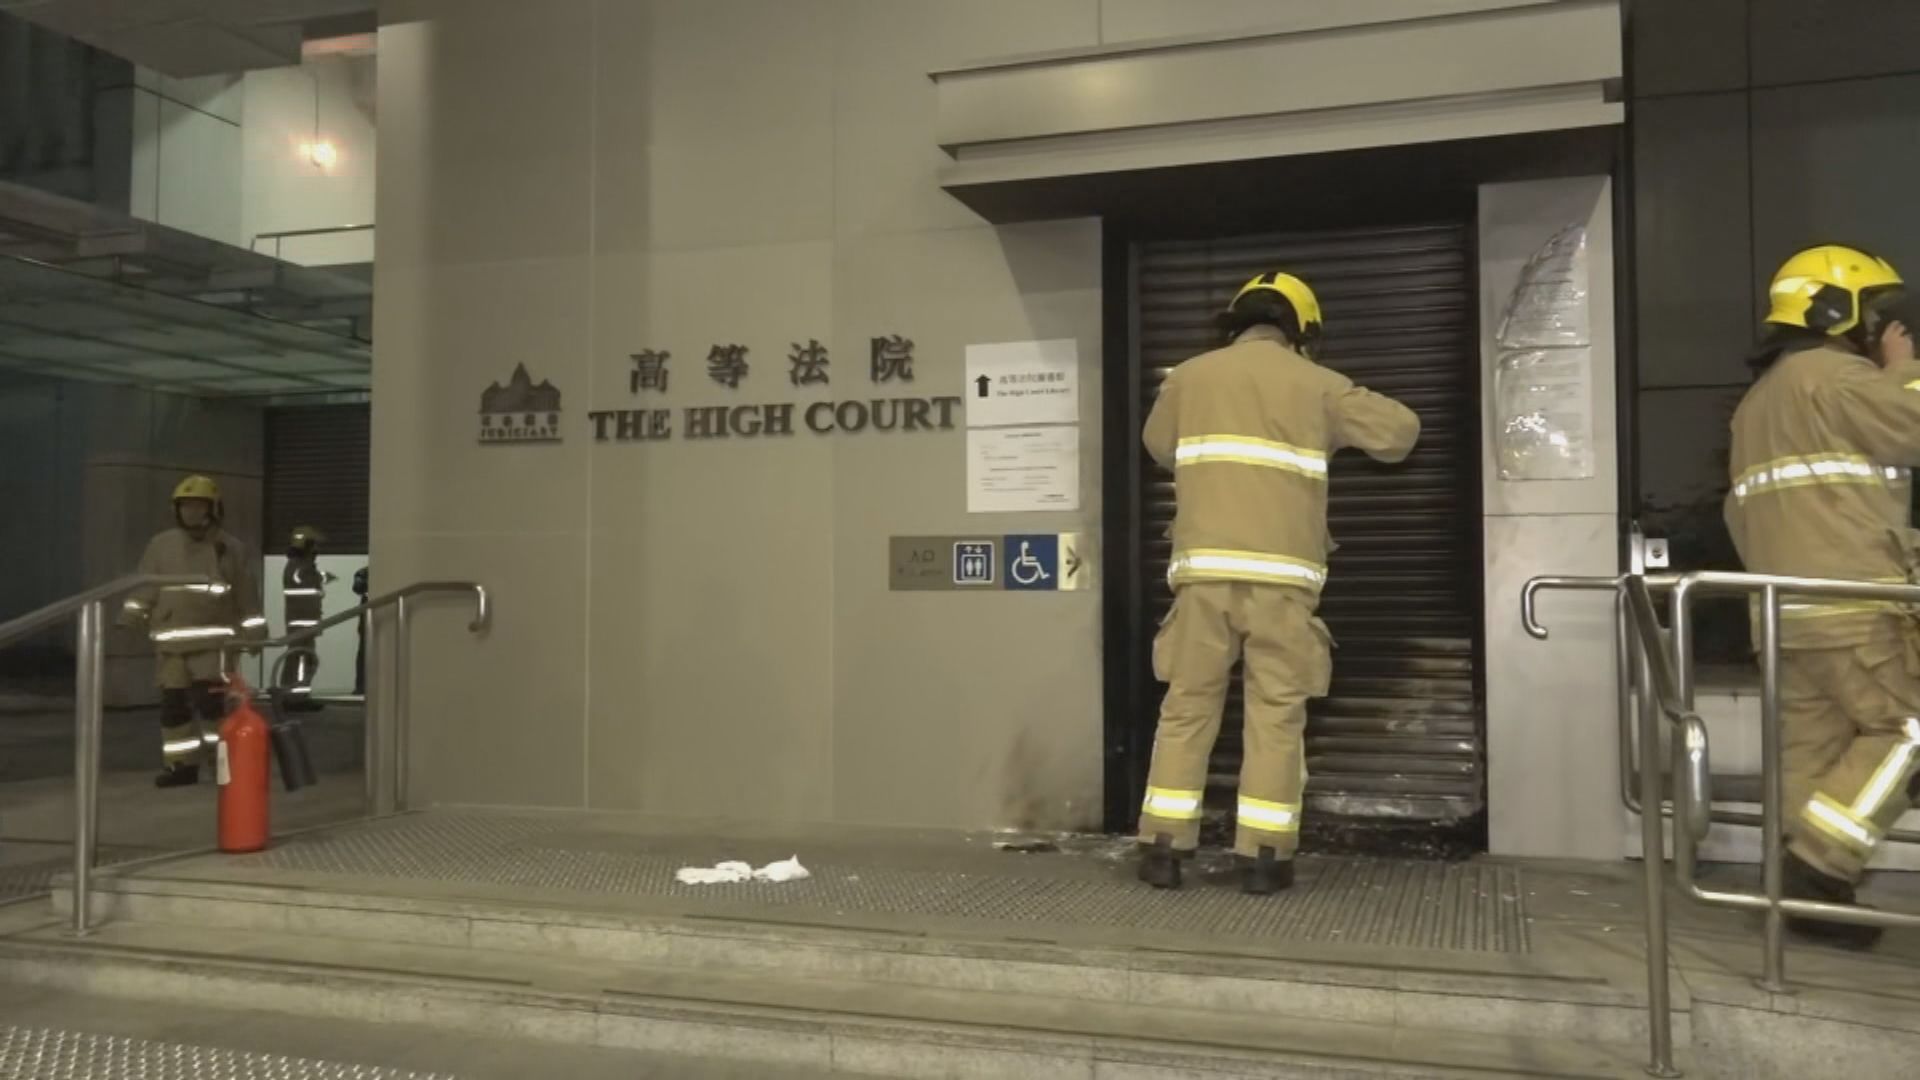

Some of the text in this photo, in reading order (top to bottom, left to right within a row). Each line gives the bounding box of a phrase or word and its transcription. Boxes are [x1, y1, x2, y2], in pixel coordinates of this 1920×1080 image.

[630, 335, 914, 393] 高等法院
[588, 396, 961, 441] THE HIGH COURT
